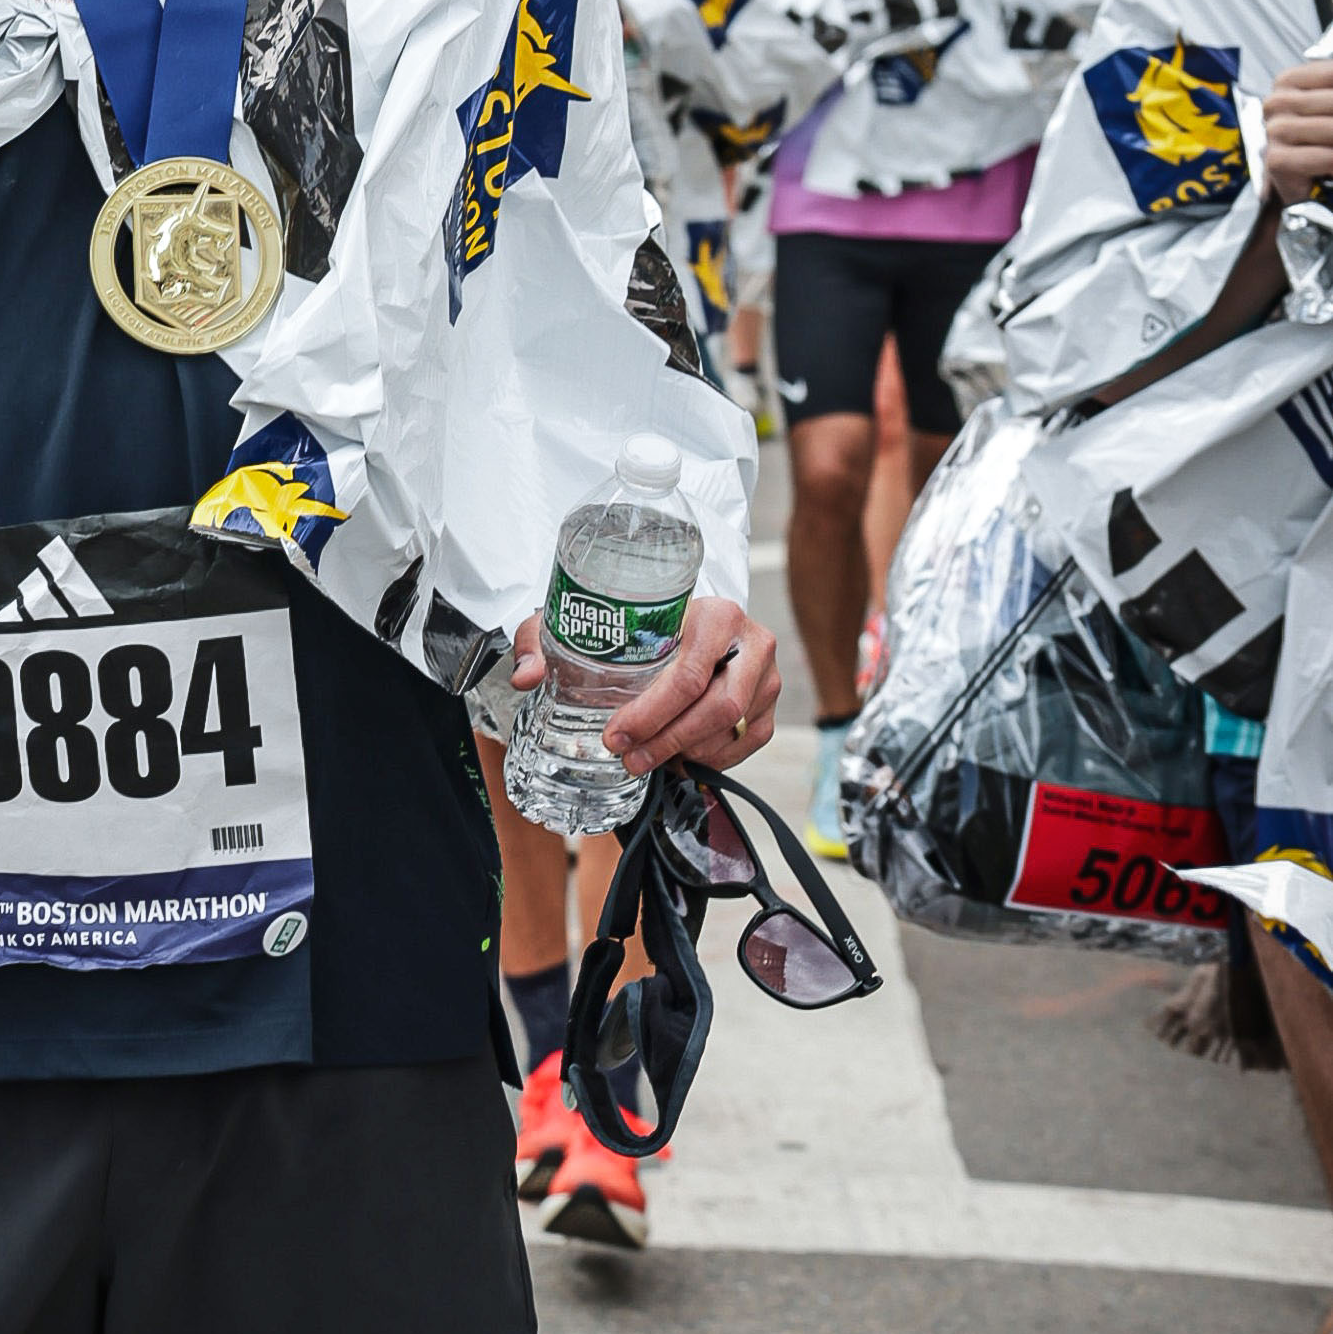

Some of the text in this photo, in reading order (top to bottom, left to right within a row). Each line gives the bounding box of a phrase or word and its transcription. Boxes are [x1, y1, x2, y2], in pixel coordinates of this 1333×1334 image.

[124, 166, 189, 197] BOSTON
[560, 591, 625, 627] Poland
[558, 613, 625, 646] Spring
[17, 901, 117, 926] BOSTON
[123, 892, 267, 924] MARATHON
[23, 932, 45, 947] OF
[51, 930, 138, 947] AMERICA
[843, 934, 864, 963] XEVO
